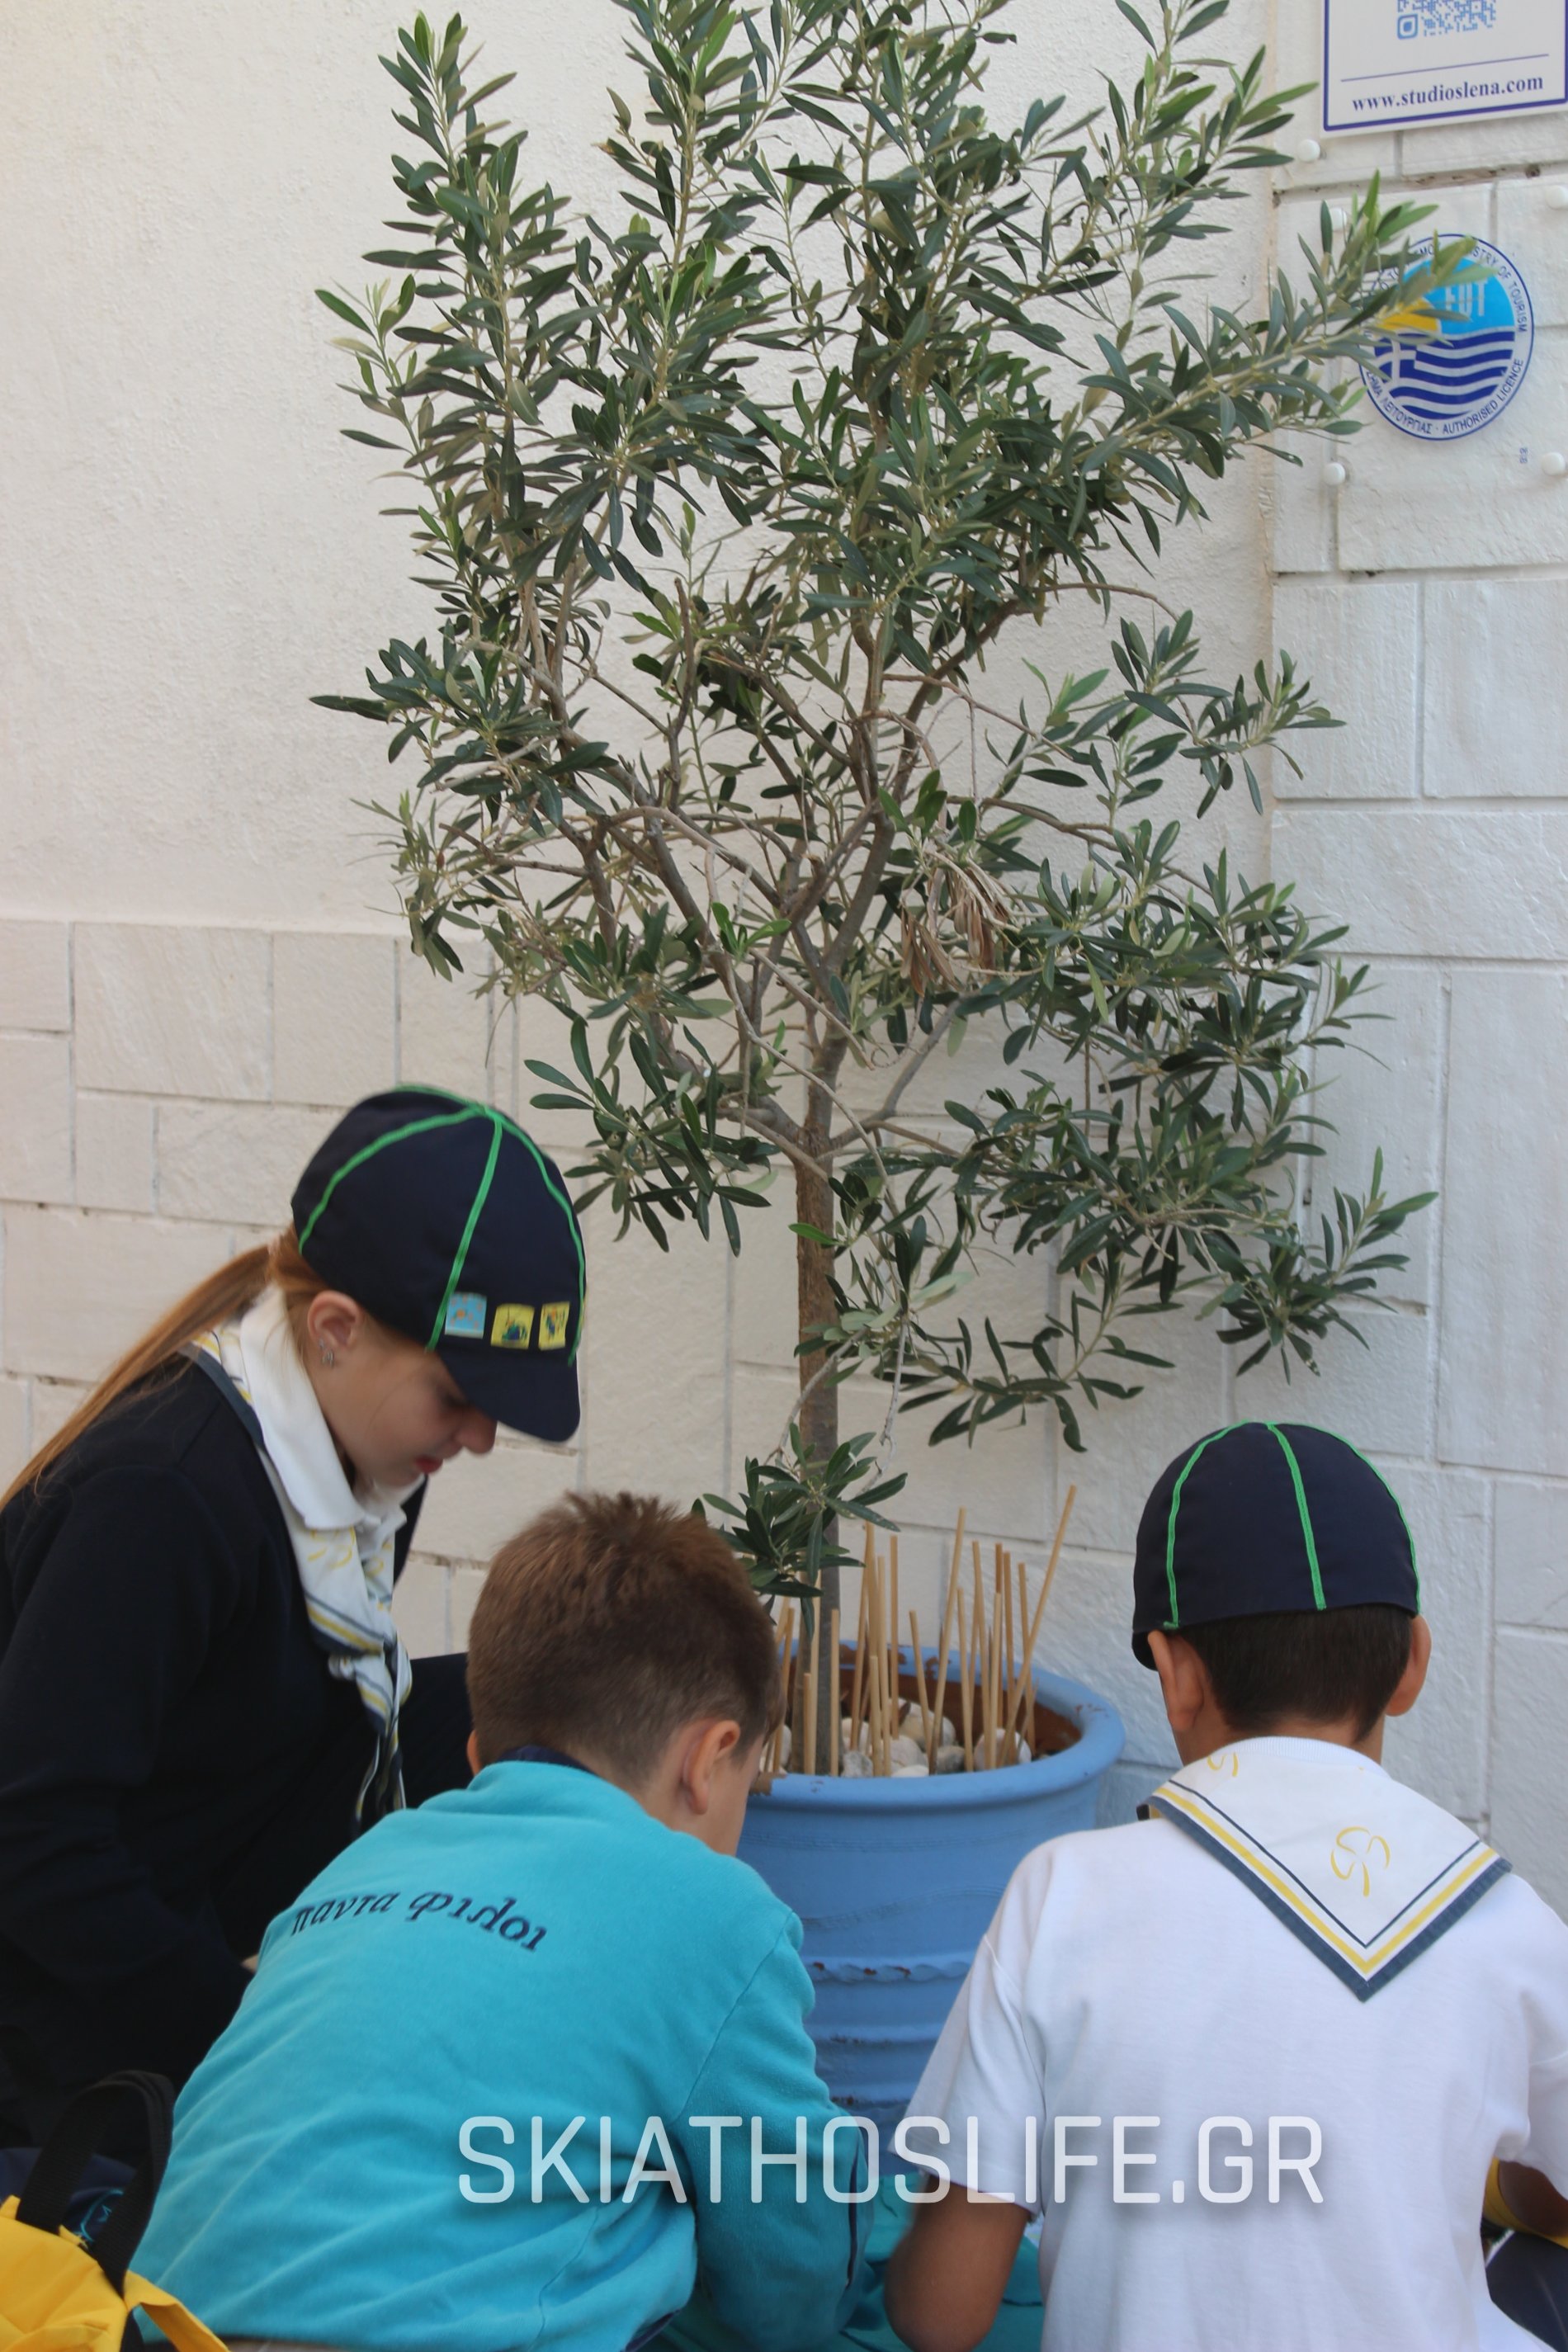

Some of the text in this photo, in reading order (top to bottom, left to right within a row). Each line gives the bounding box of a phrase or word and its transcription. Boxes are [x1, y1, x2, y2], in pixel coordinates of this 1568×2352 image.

[1352, 76, 1544, 111] www.studioslena.com
[1497, 265, 1512, 280] OF
[1509, 281, 1528, 333] TOURISM
[1443, 358, 1524, 435] AUTHORISED LICENCE
